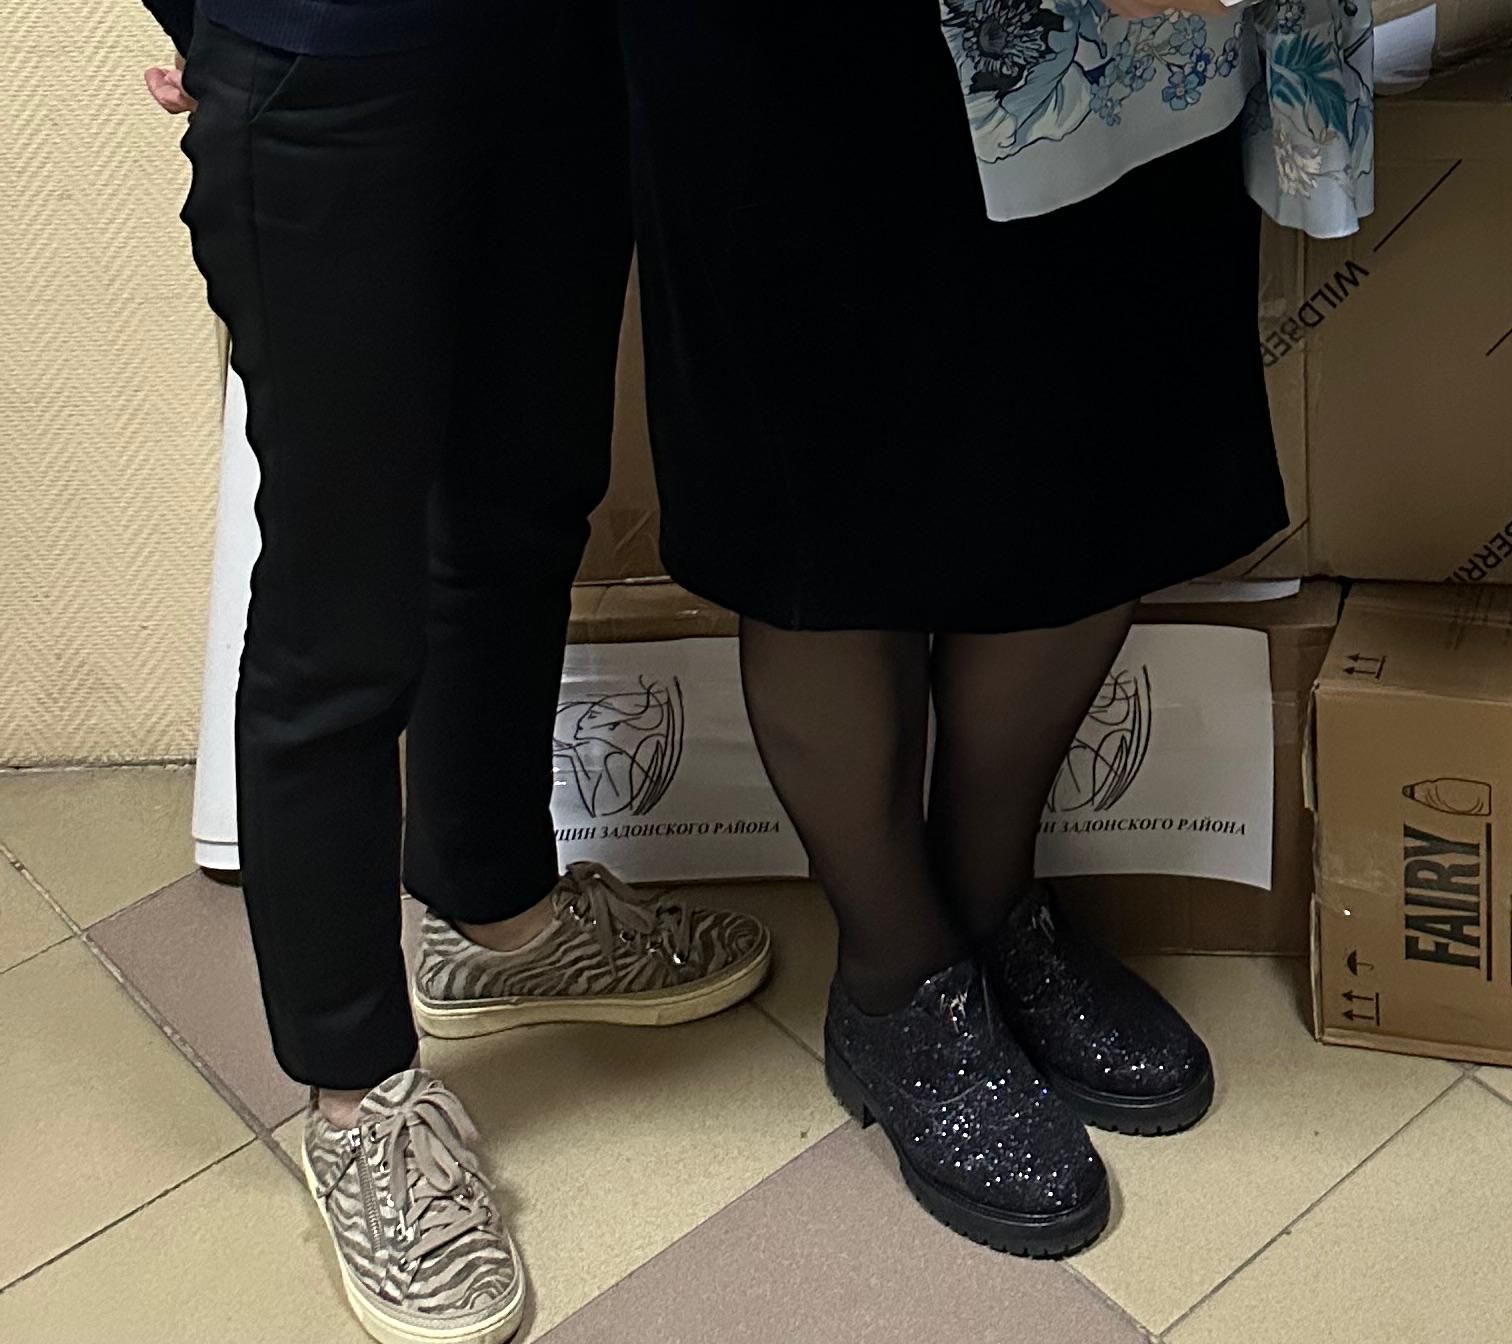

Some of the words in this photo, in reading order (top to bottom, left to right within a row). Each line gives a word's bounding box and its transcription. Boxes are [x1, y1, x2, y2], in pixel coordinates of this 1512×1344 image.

[600, 823, 710, 840] ЗАДОНСКОГО
[714, 819, 780, 835] РАЙОНА
[1062, 818, 1173, 834] ЗАДОНСКОГО
[1177, 817, 1246, 836] РАЙОНА
[1403, 823, 1482, 970] FAIRY
